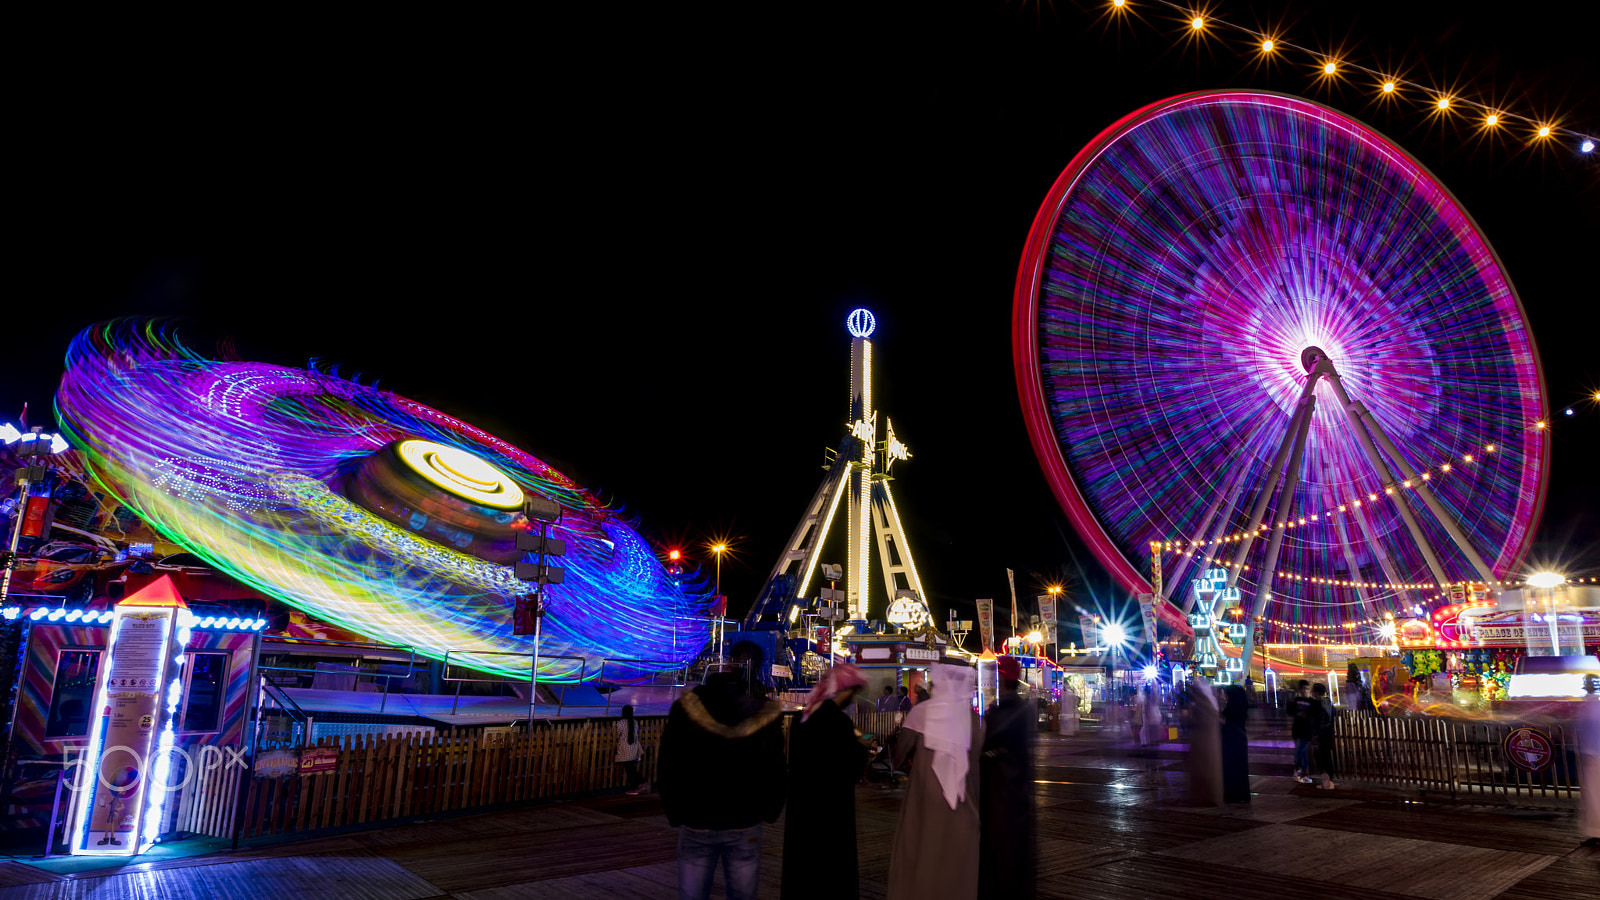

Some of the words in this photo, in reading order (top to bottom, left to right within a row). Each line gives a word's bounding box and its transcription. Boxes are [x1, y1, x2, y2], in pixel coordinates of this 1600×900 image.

[852, 420, 875, 451] AIR
[1479, 627, 1512, 639] PALACE
[1514, 627, 1524, 638] OF
[255, 757, 298, 771] ENTRANCE
